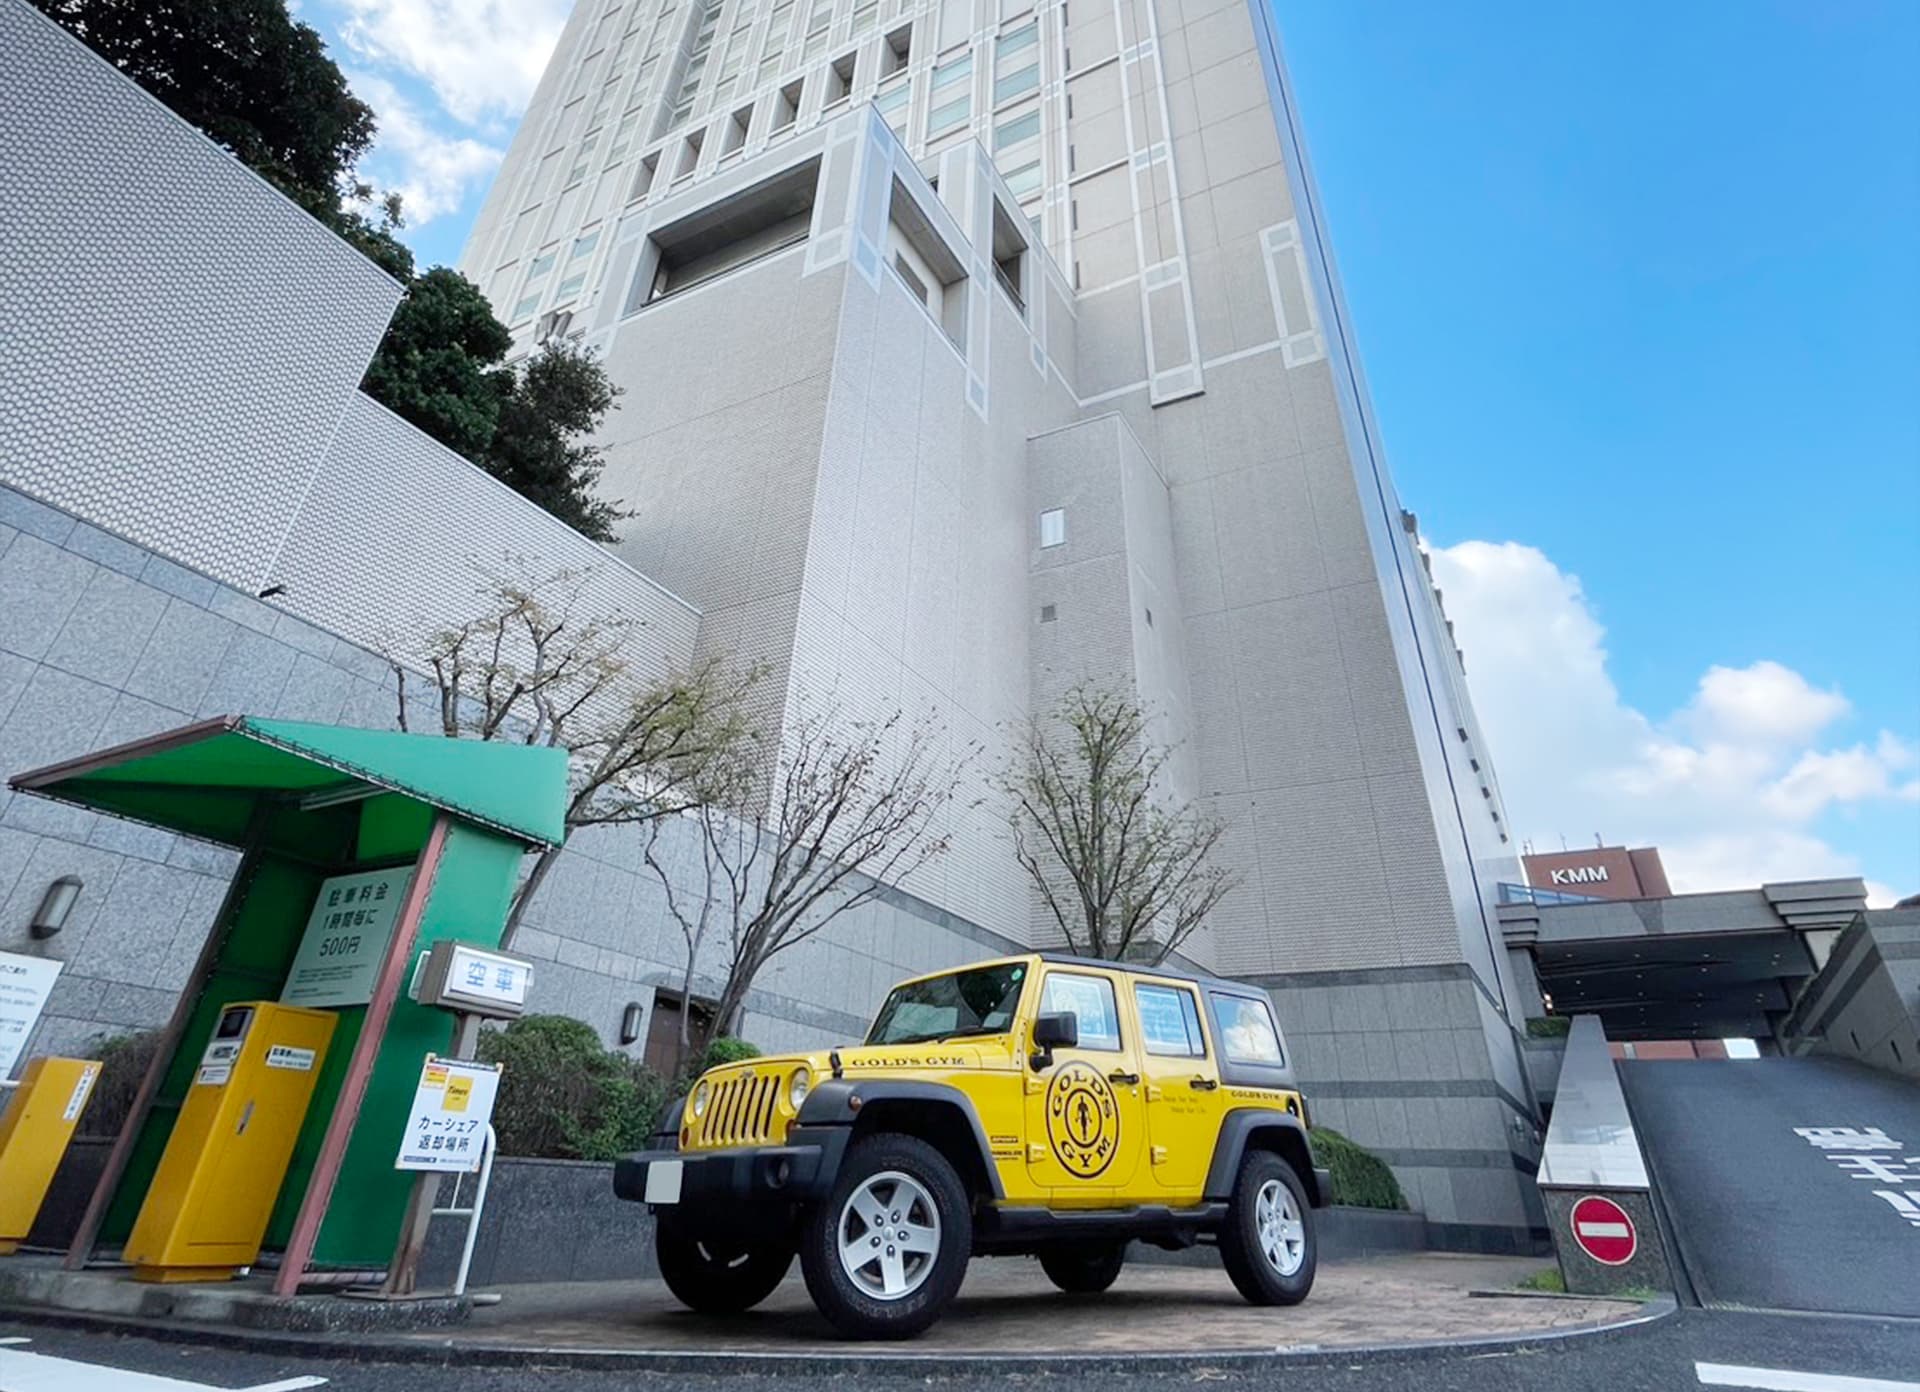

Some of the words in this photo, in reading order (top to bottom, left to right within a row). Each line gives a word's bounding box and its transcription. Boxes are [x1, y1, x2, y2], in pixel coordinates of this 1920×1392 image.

[1551, 866, 1608, 884] KMM
[327, 882, 389, 907] 駐車料金
[319, 936, 361, 957] 500円
[466, 961, 515, 992] 空車
[852, 1057, 920, 1066] GOLD'S
[1053, 1069, 1112, 1118] GOLD'S
[418, 1116, 479, 1133] カーシェア
[418, 1134, 470, 1152] 返却場所
[1060, 1135, 1111, 1168] GYM
